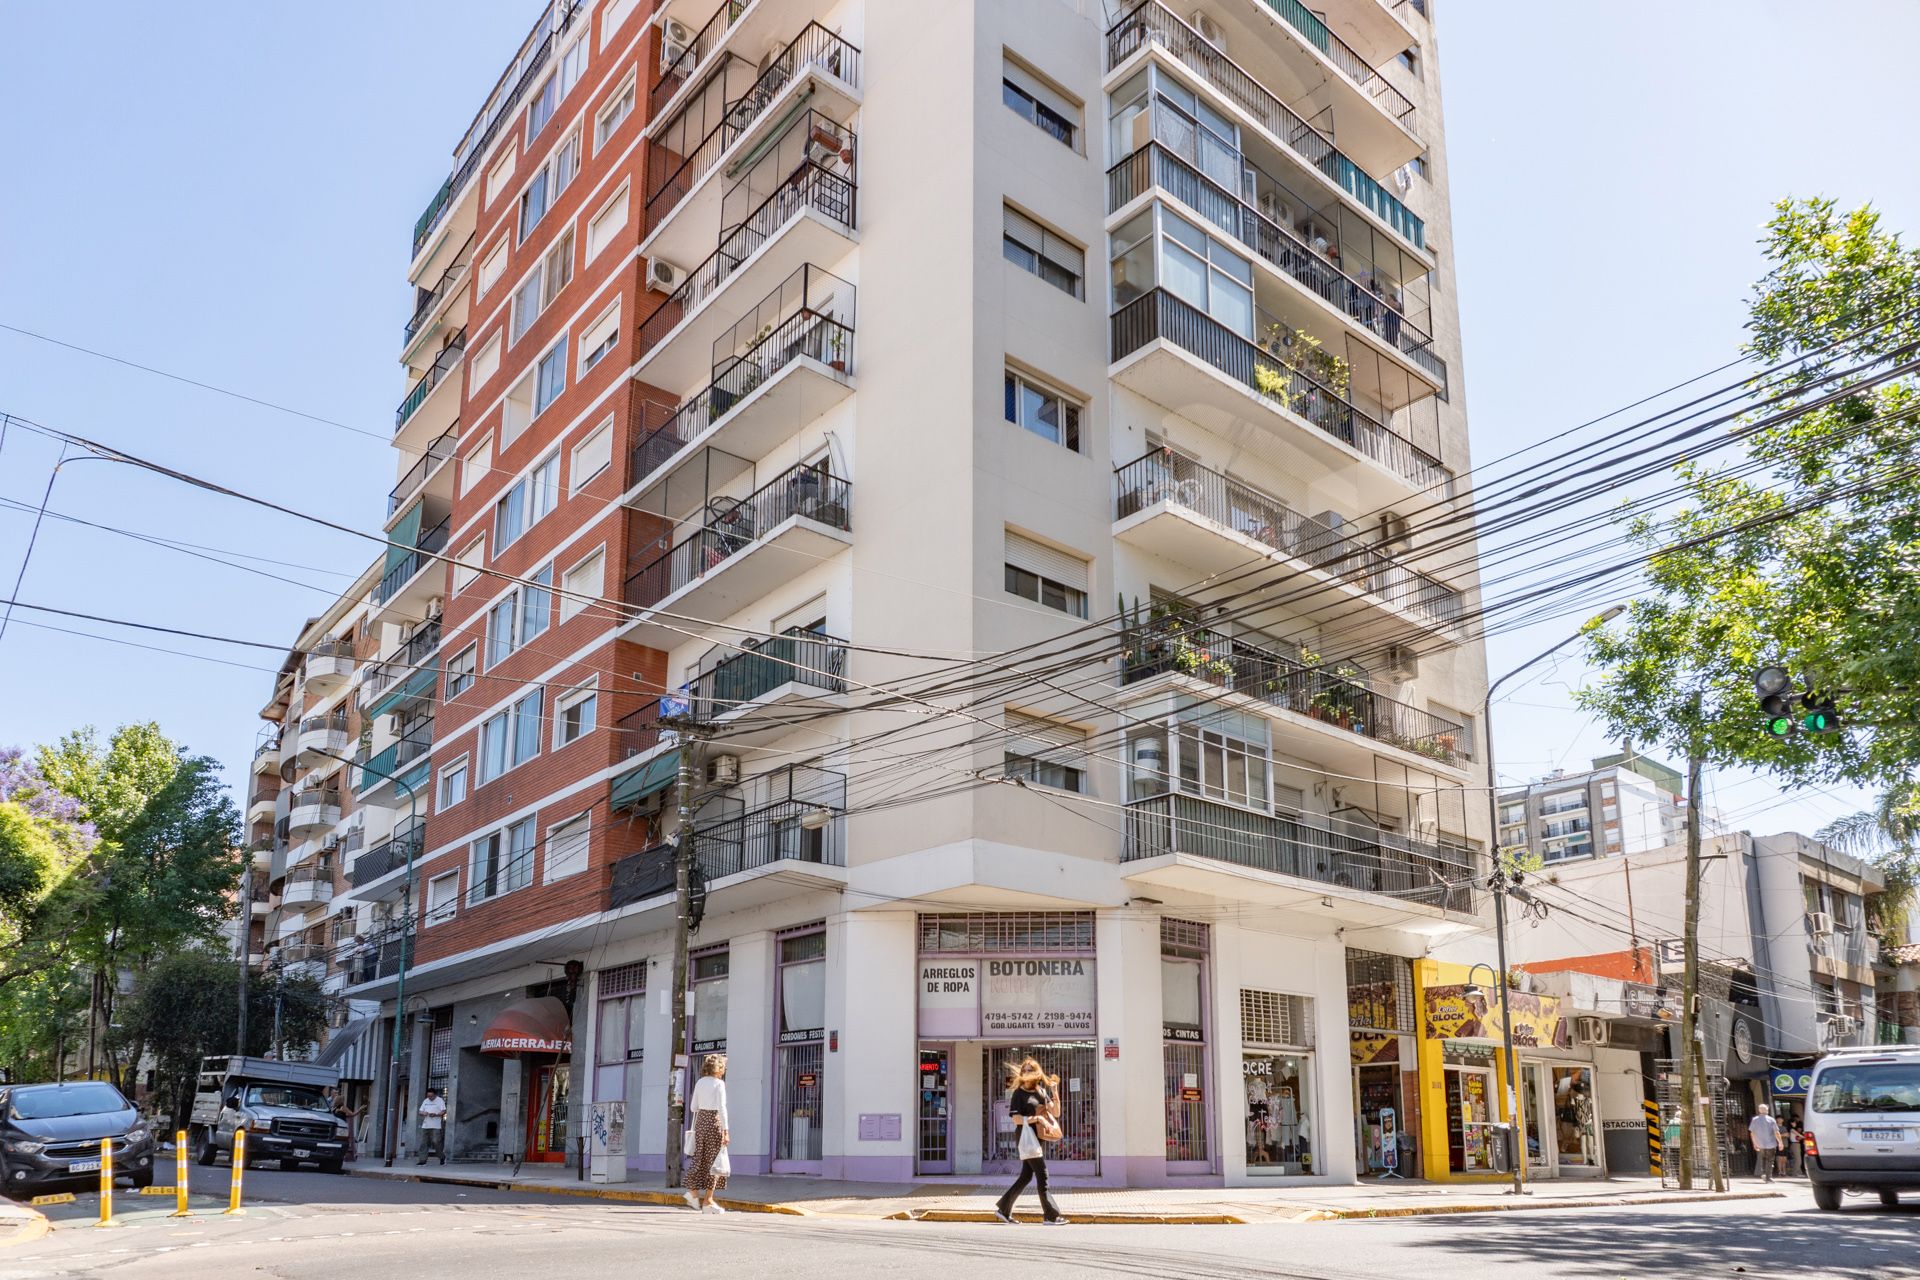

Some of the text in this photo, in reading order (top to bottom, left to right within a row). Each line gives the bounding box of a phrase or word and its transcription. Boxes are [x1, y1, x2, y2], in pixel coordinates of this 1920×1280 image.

[922, 967, 975, 979] ARREGLOS
[989, 960, 1085, 976] BOTONERA
[927, 982, 970, 993] DE ROPA
[984, 1012, 1033, 1021] 4794-5742
[1044, 1012, 1092, 1021] 2198-9474
[1432, 1012, 1464, 1022] BLOCK
[781, 1031, 807, 1041] CORDONES
[1175, 1029, 1199, 1040] CINTAS
[1512, 1034, 1538, 1047] BLOCK
